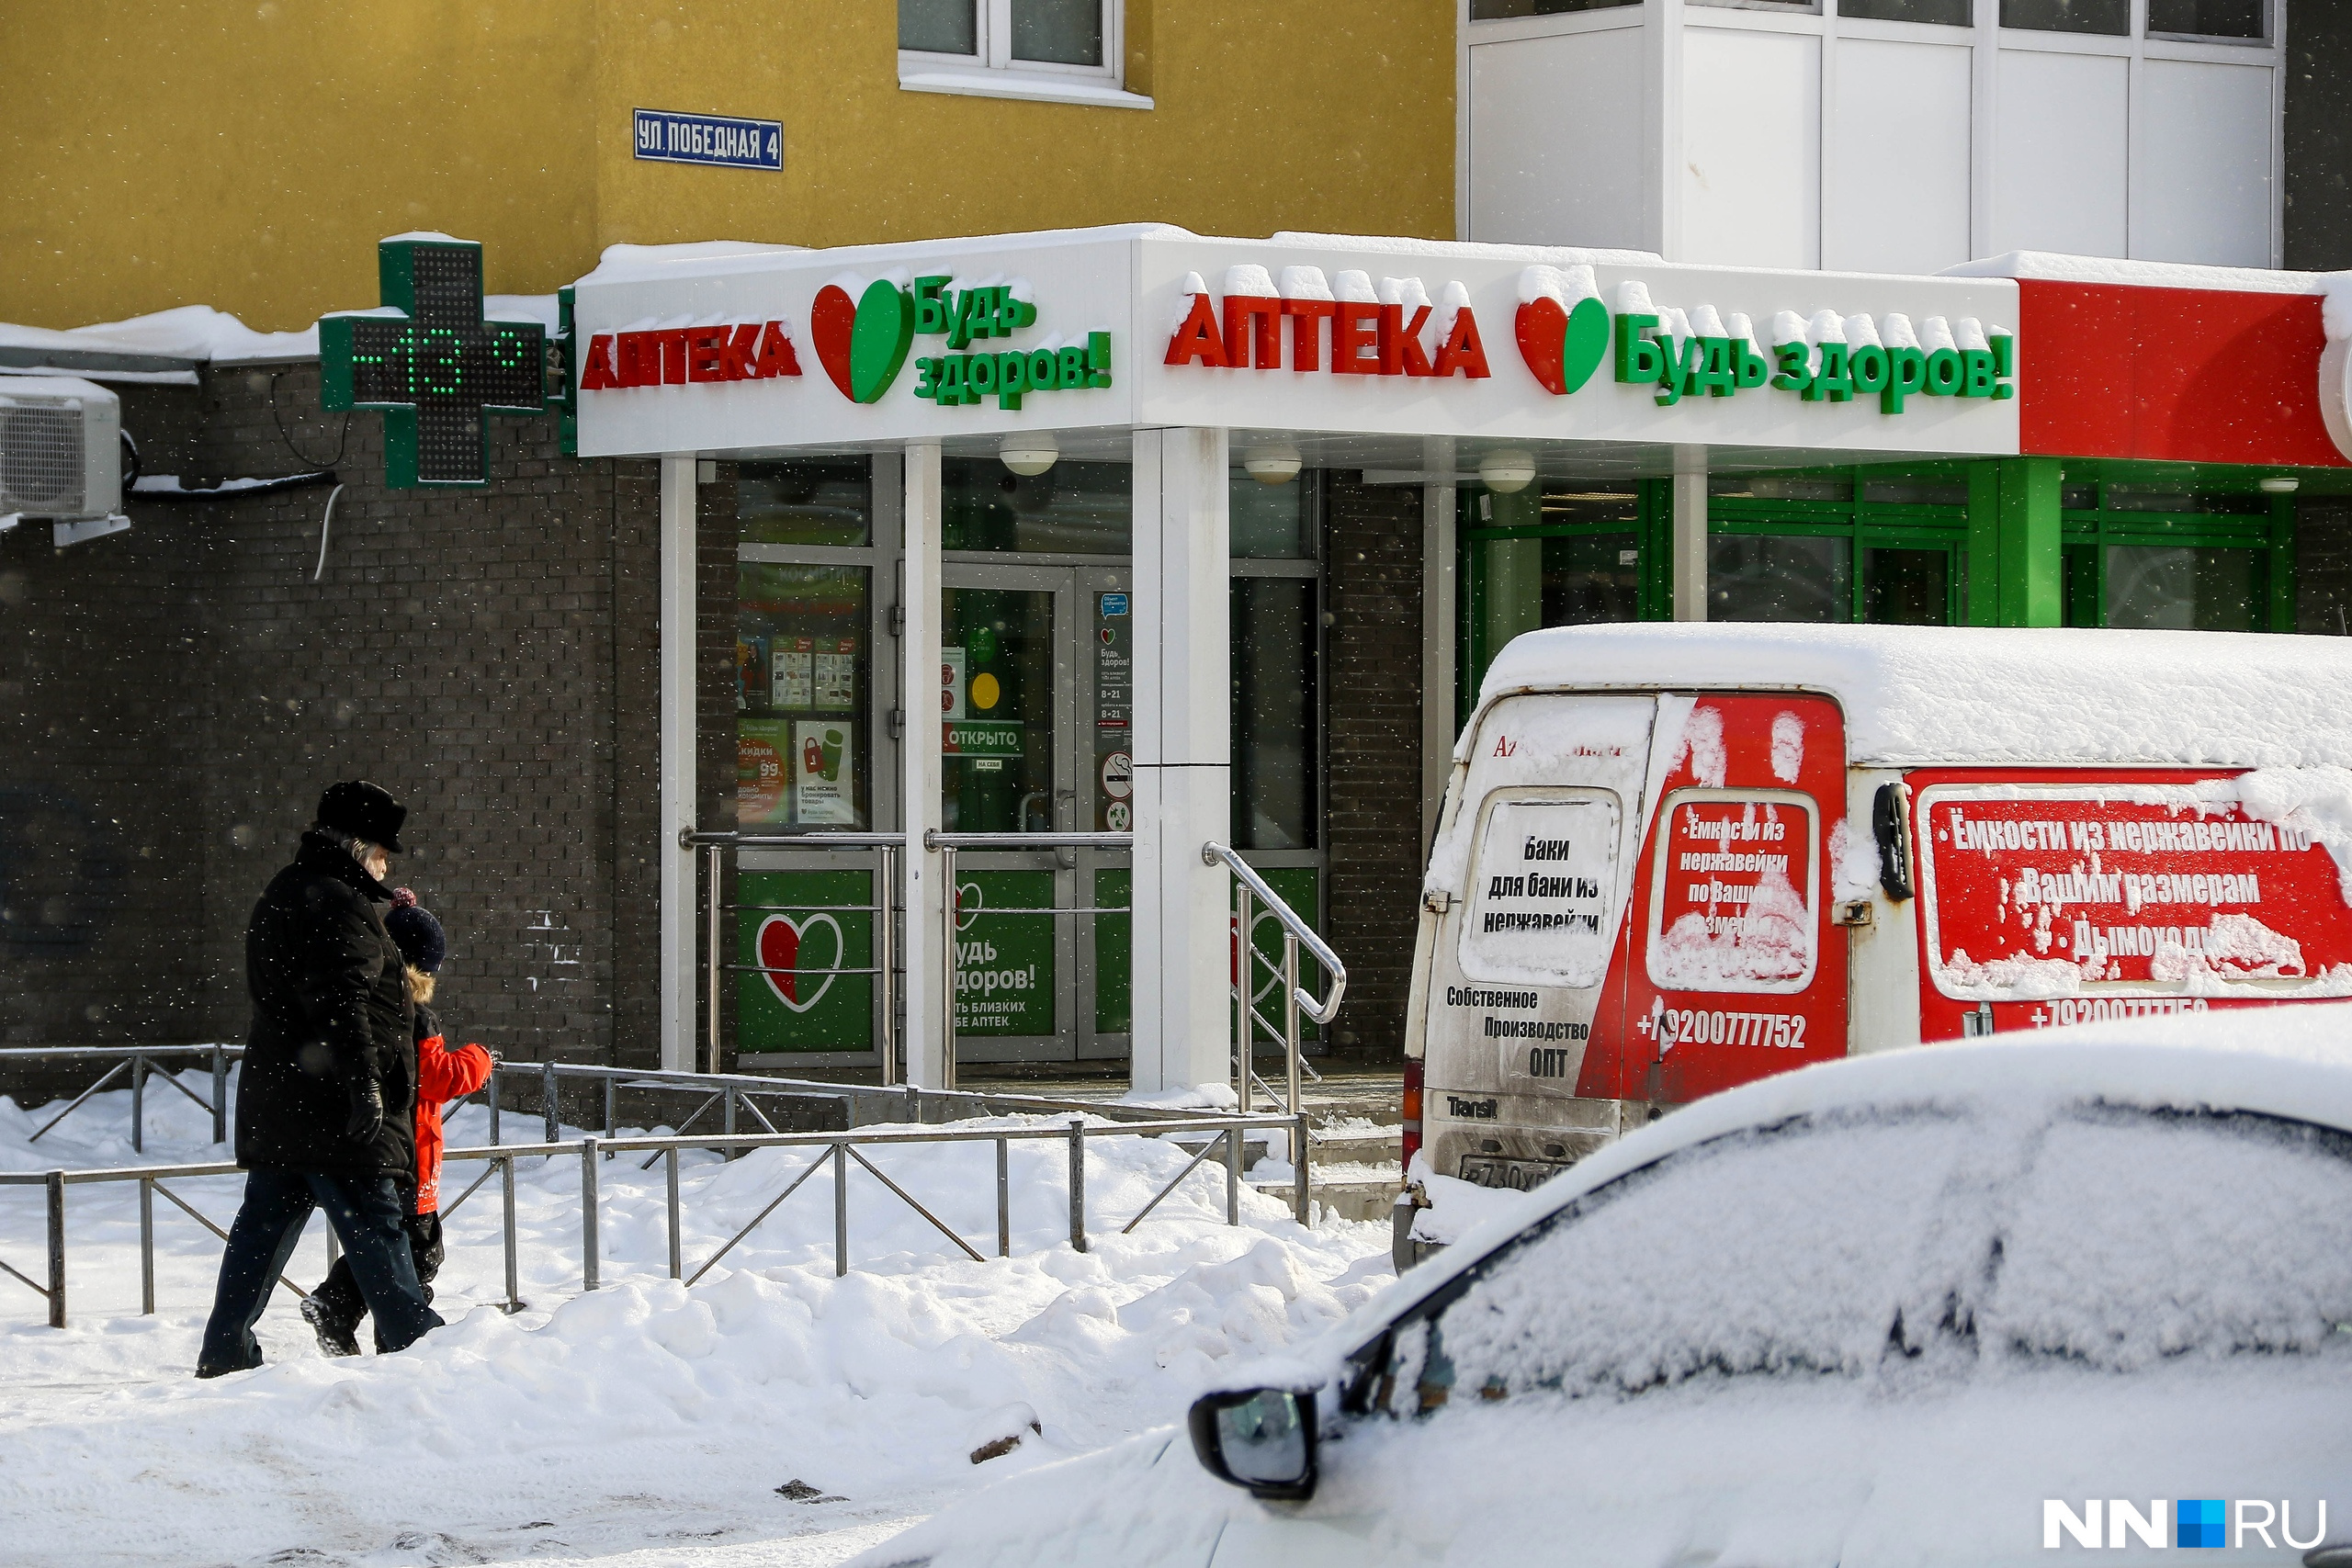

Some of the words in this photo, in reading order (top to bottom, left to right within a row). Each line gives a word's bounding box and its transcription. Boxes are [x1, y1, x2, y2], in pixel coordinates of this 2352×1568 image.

[639, 119, 665, 150] УЛ.
[669, 121, 761, 158] ПОБЕДНАЯ
[766, 131, 779, 160] 4
[915, 276, 1036, 349] Будь
[580, 319, 803, 390] АПТЕКА
[1164, 292, 1492, 379] АПТЕКА
[1614, 312, 1768, 406] Будь
[1771, 334, 2015, 415] здоров!
[914, 331, 1112, 411] здоров!
[1101, 648, 1119, 660] Будь
[1101, 658, 1130, 668] здоров!
[949, 730, 1017, 746] ОТКРЫТО
[739, 748, 773, 757] КИДКИ
[1763, 821, 1786, 841] из
[1951, 807, 2069, 852] Ёмкости
[2070, 820, 2107, 852] из
[2109, 812, 2277, 855] нержавейки
[1524, 835, 1570, 861] Баки
[1488, 875, 1524, 900] для
[1528, 872, 1573, 897] бани
[1689, 884, 1709, 902] по
[2021, 867, 2122, 903] Вашим
[2124, 873, 2262, 909] размерам
[956, 942, 998, 969] удь
[956, 964, 1035, 998] доров!
[971, 1001, 1026, 1013] БЛИЗКИХ
[1447, 986, 1539, 1010] Собственное
[971, 1016, 1010, 1027] АПТЕК
[1485, 1017, 1590, 1042] Производство
[1529, 1048, 1568, 1078] ОПТ
[1447, 1096, 1498, 1119] Transit
